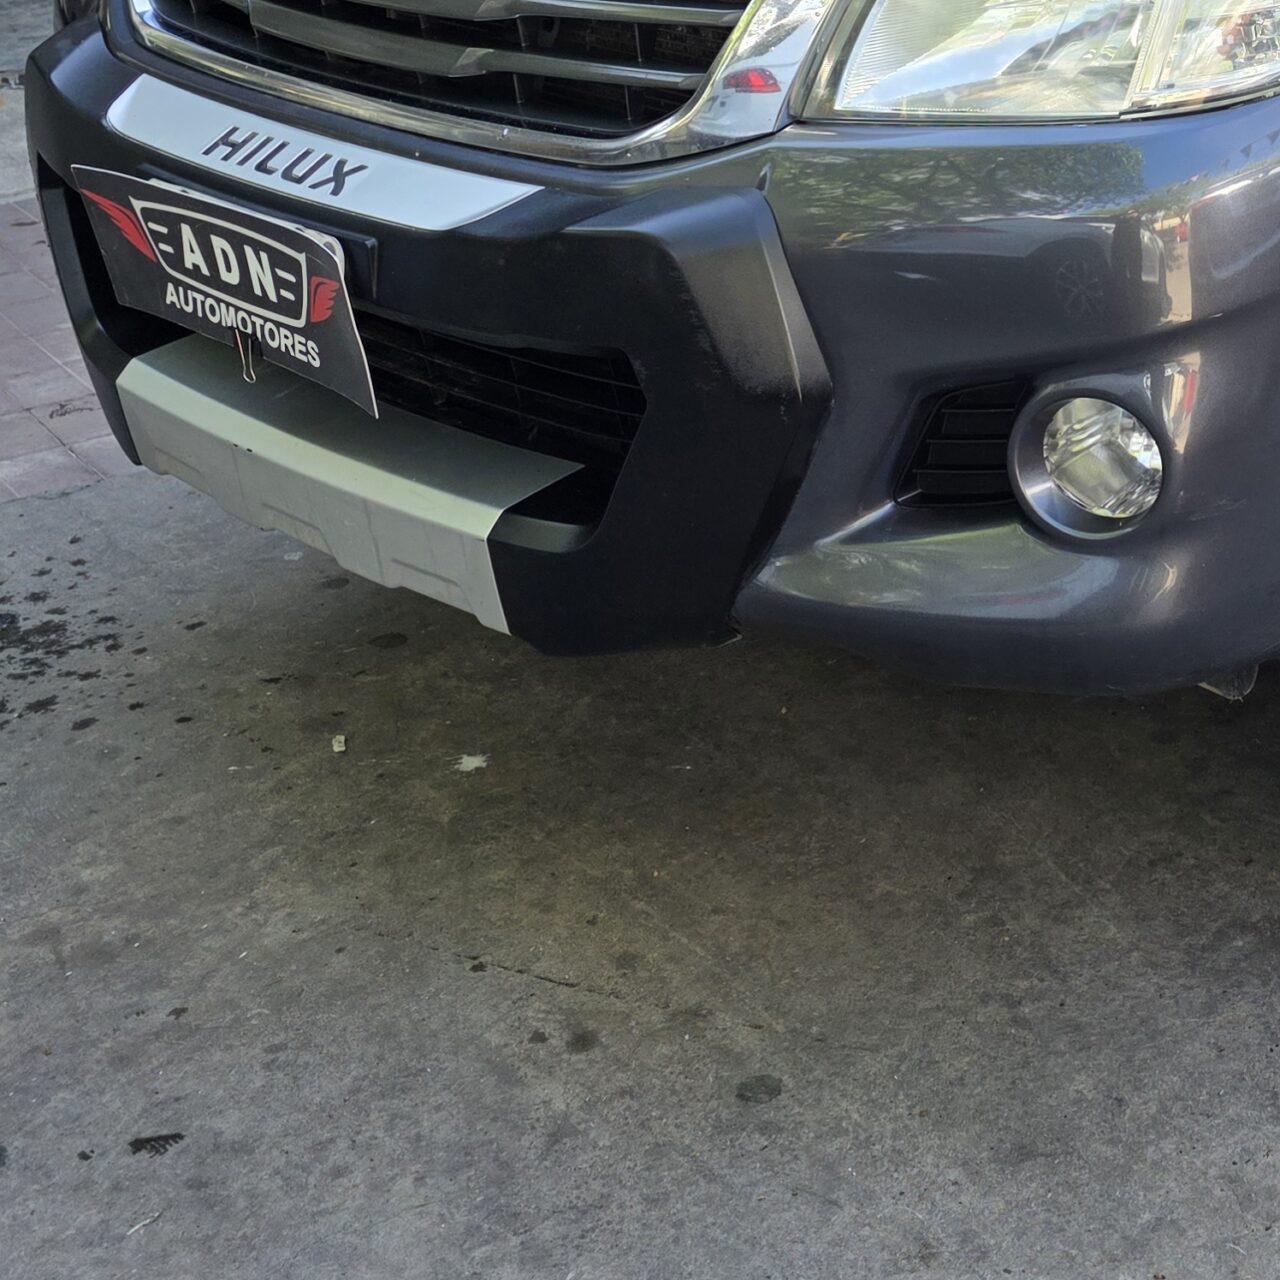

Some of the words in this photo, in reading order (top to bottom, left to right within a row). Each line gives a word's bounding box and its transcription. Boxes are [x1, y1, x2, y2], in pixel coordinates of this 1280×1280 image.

[201, 125, 369, 197] HILUX
[180, 222, 278, 303] ADN
[165, 282, 321, 368] AUTOMOTORES
